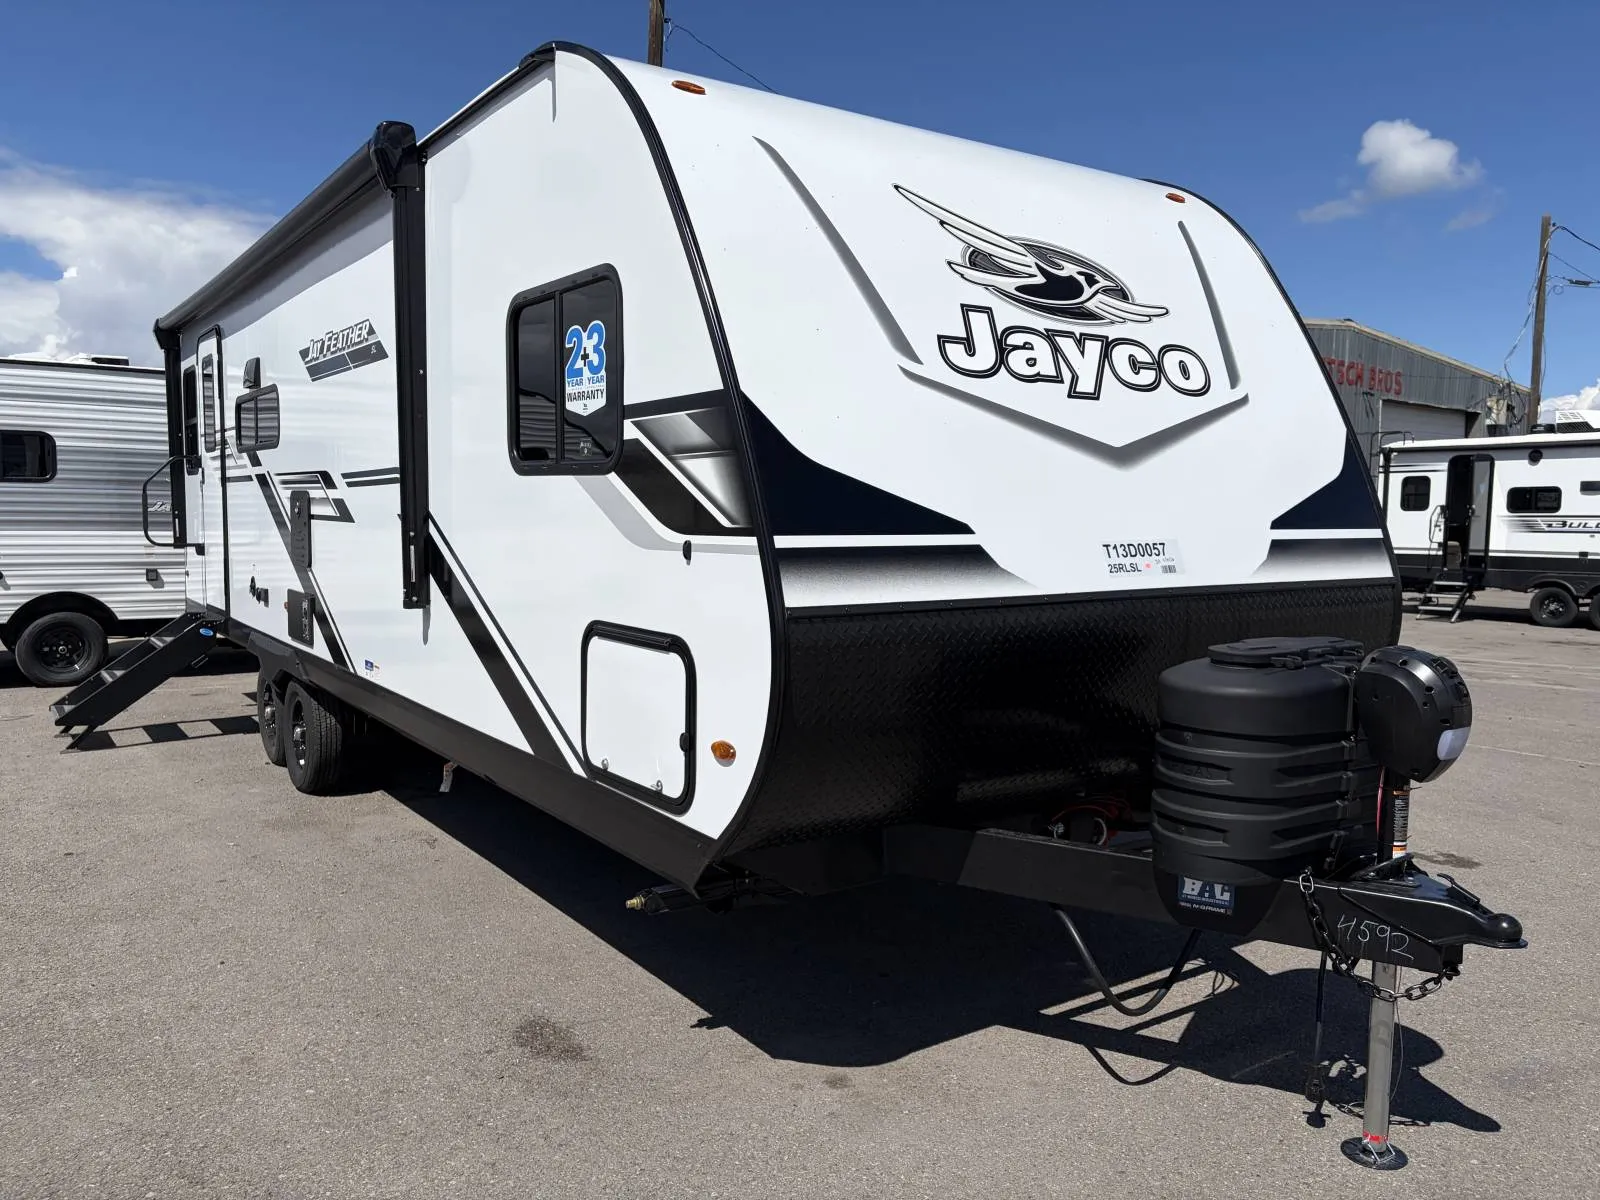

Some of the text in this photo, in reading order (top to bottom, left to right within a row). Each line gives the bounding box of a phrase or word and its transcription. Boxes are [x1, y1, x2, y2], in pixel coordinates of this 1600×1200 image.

[323, 320, 370, 355] FEATHER
[937, 303, 1211, 400] Jayco
[567, 378, 584, 388] YEAR
[587, 375, 605, 385] YEAR
[1368, 366, 1402, 395] BROS
[567, 389, 605, 402] WARRANTY
[1102, 543, 1166, 558] T13D0057
[1108, 563, 1142, 573] 25RLSL
